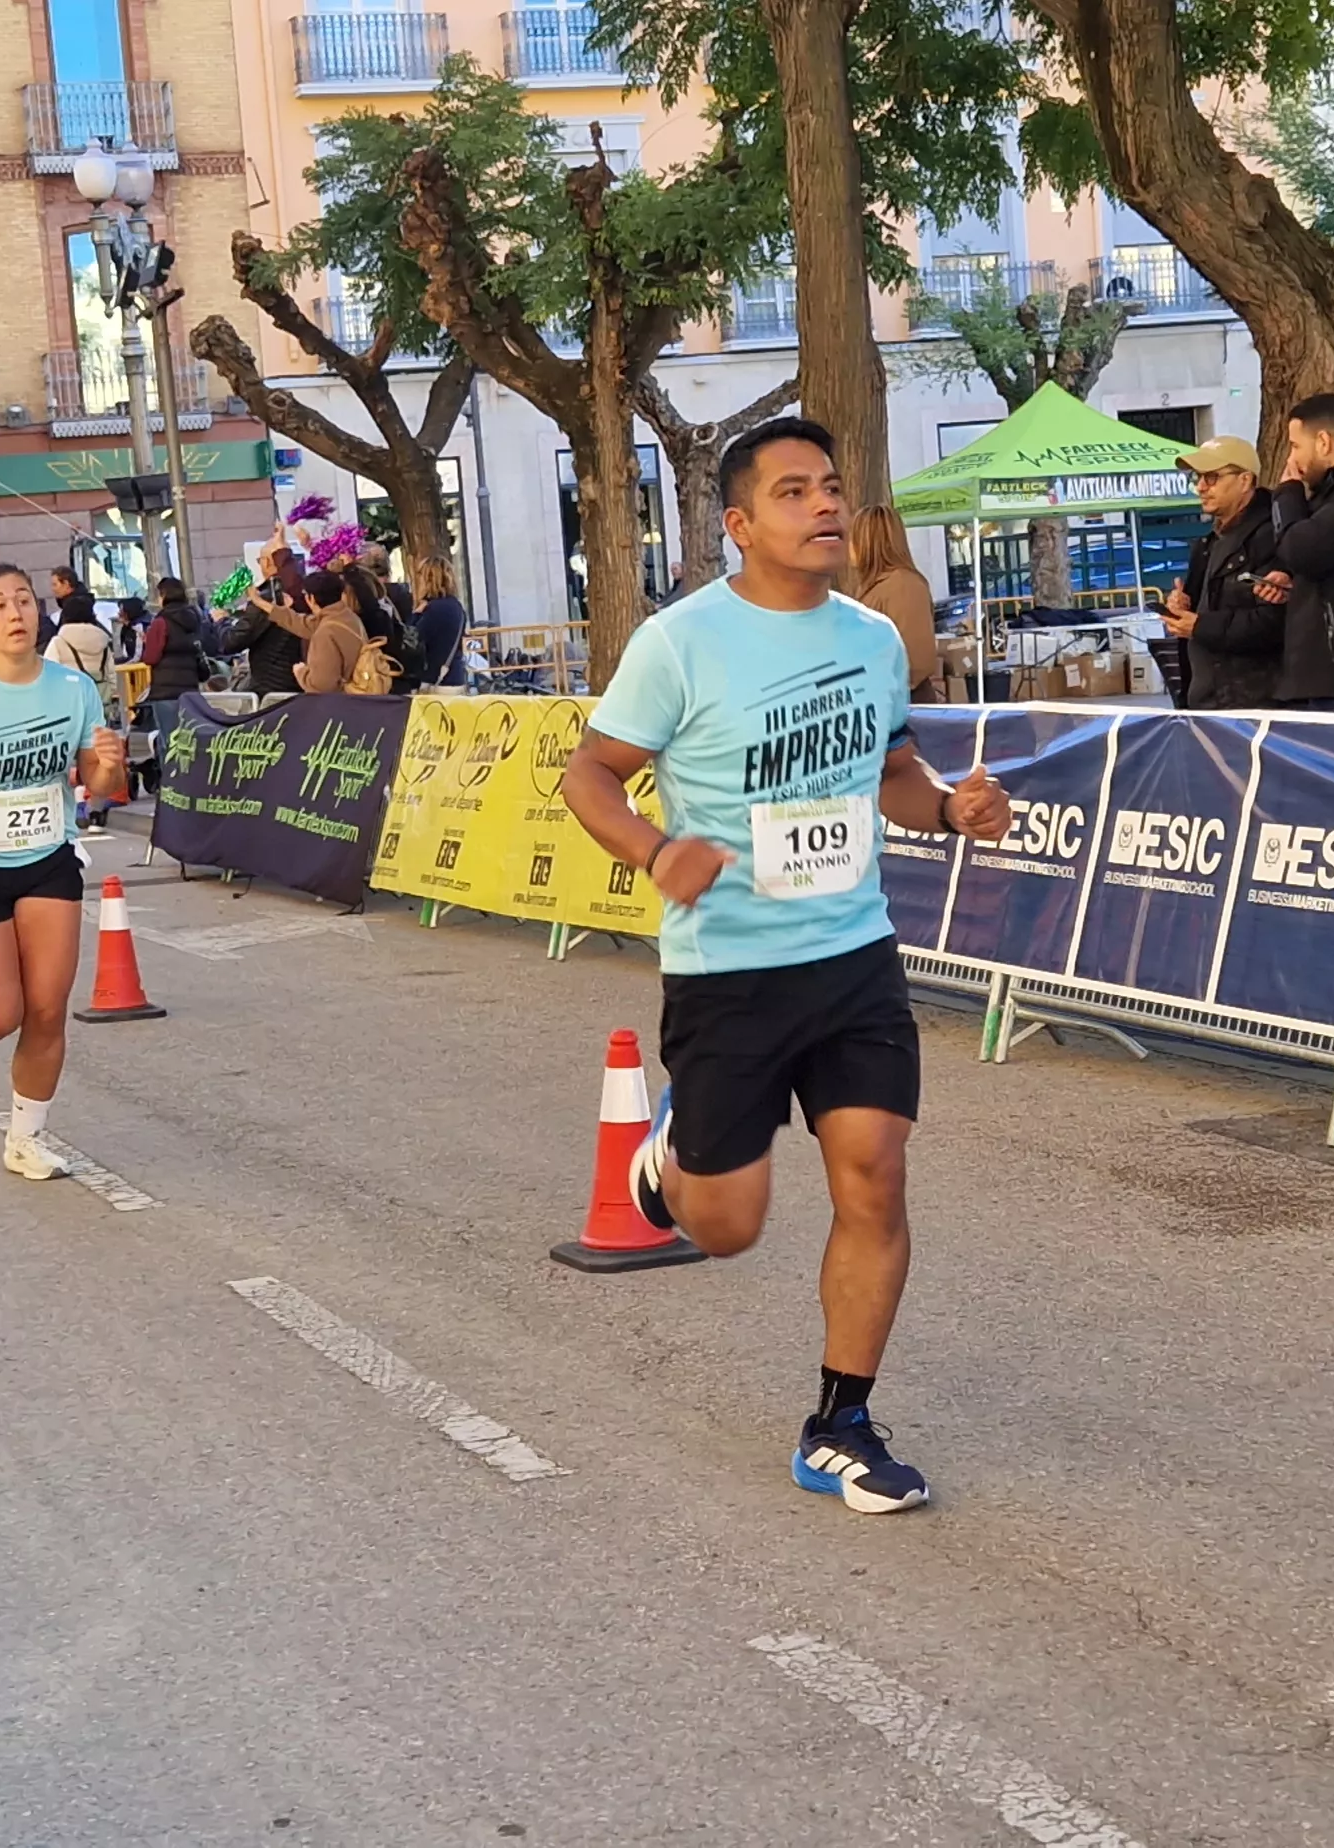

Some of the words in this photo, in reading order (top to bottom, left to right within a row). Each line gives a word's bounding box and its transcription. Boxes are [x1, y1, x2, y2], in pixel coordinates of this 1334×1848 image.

[1161, 392, 1170, 406] 2
[1060, 442, 1154, 455] FARTLECK
[1075, 454, 1162, 466] SPORT
[1066, 473, 1187, 501] AVITUALLAMIENTO
[765, 705, 787, 735] III
[792, 686, 854, 724] CARRERA
[7, 732, 54, 754] CARRERA
[743, 703, 878, 793] EMPRESAS
[7, 807, 50, 828] 272
[1000, 799, 1085, 858] ESIC
[6, 825, 52, 838] CARLOTA
[785, 821, 848, 854] 109
[1135, 813, 1225, 875] ESIC
[782, 853, 851, 873] ANTONIO
